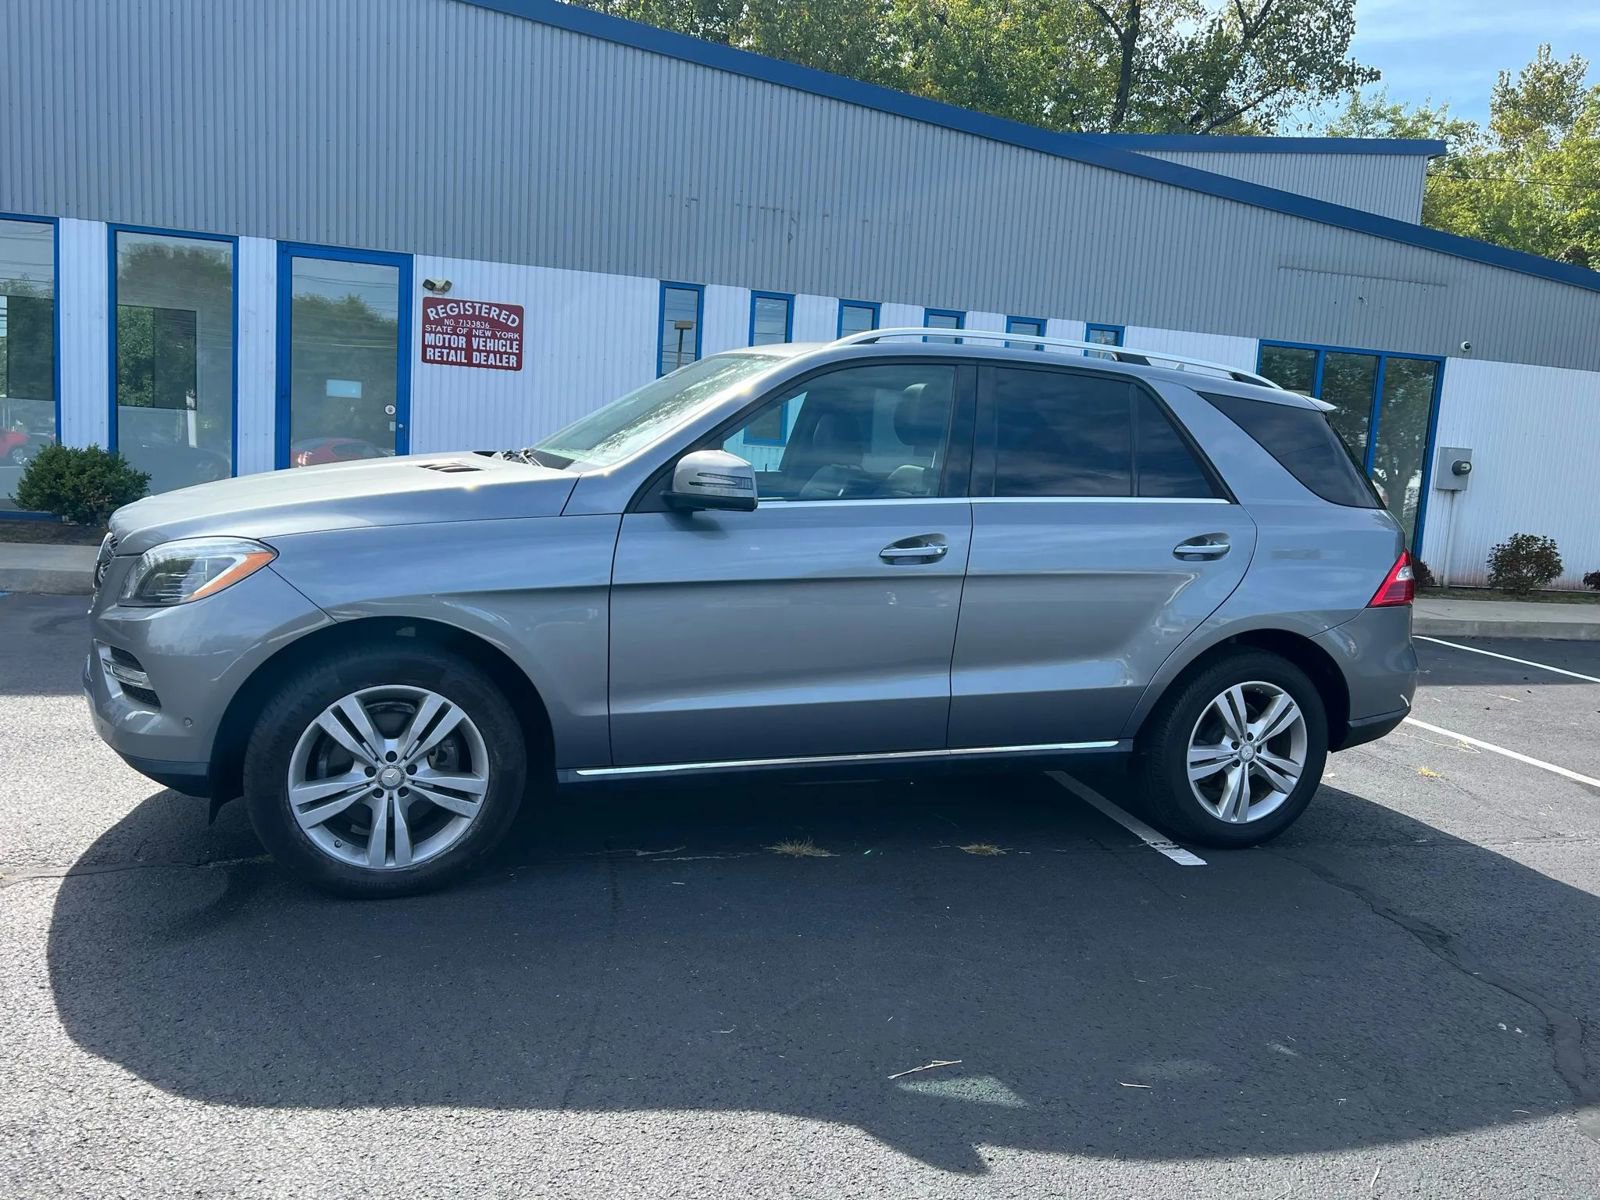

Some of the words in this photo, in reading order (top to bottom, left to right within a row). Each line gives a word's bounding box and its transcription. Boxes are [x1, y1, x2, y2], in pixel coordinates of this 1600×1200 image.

[427, 302, 520, 327] REGISTERED
[425, 325, 453, 333] STATE
[457, 327, 469, 335] OF
[472, 329, 492, 337] NEW
[495, 331, 520, 340] YORK
[424, 333, 466, 348] MOTOR
[472, 338, 519, 353] VEHICLE
[426, 348, 467, 363] RETAIL
[472, 352, 517, 367] DEALER
